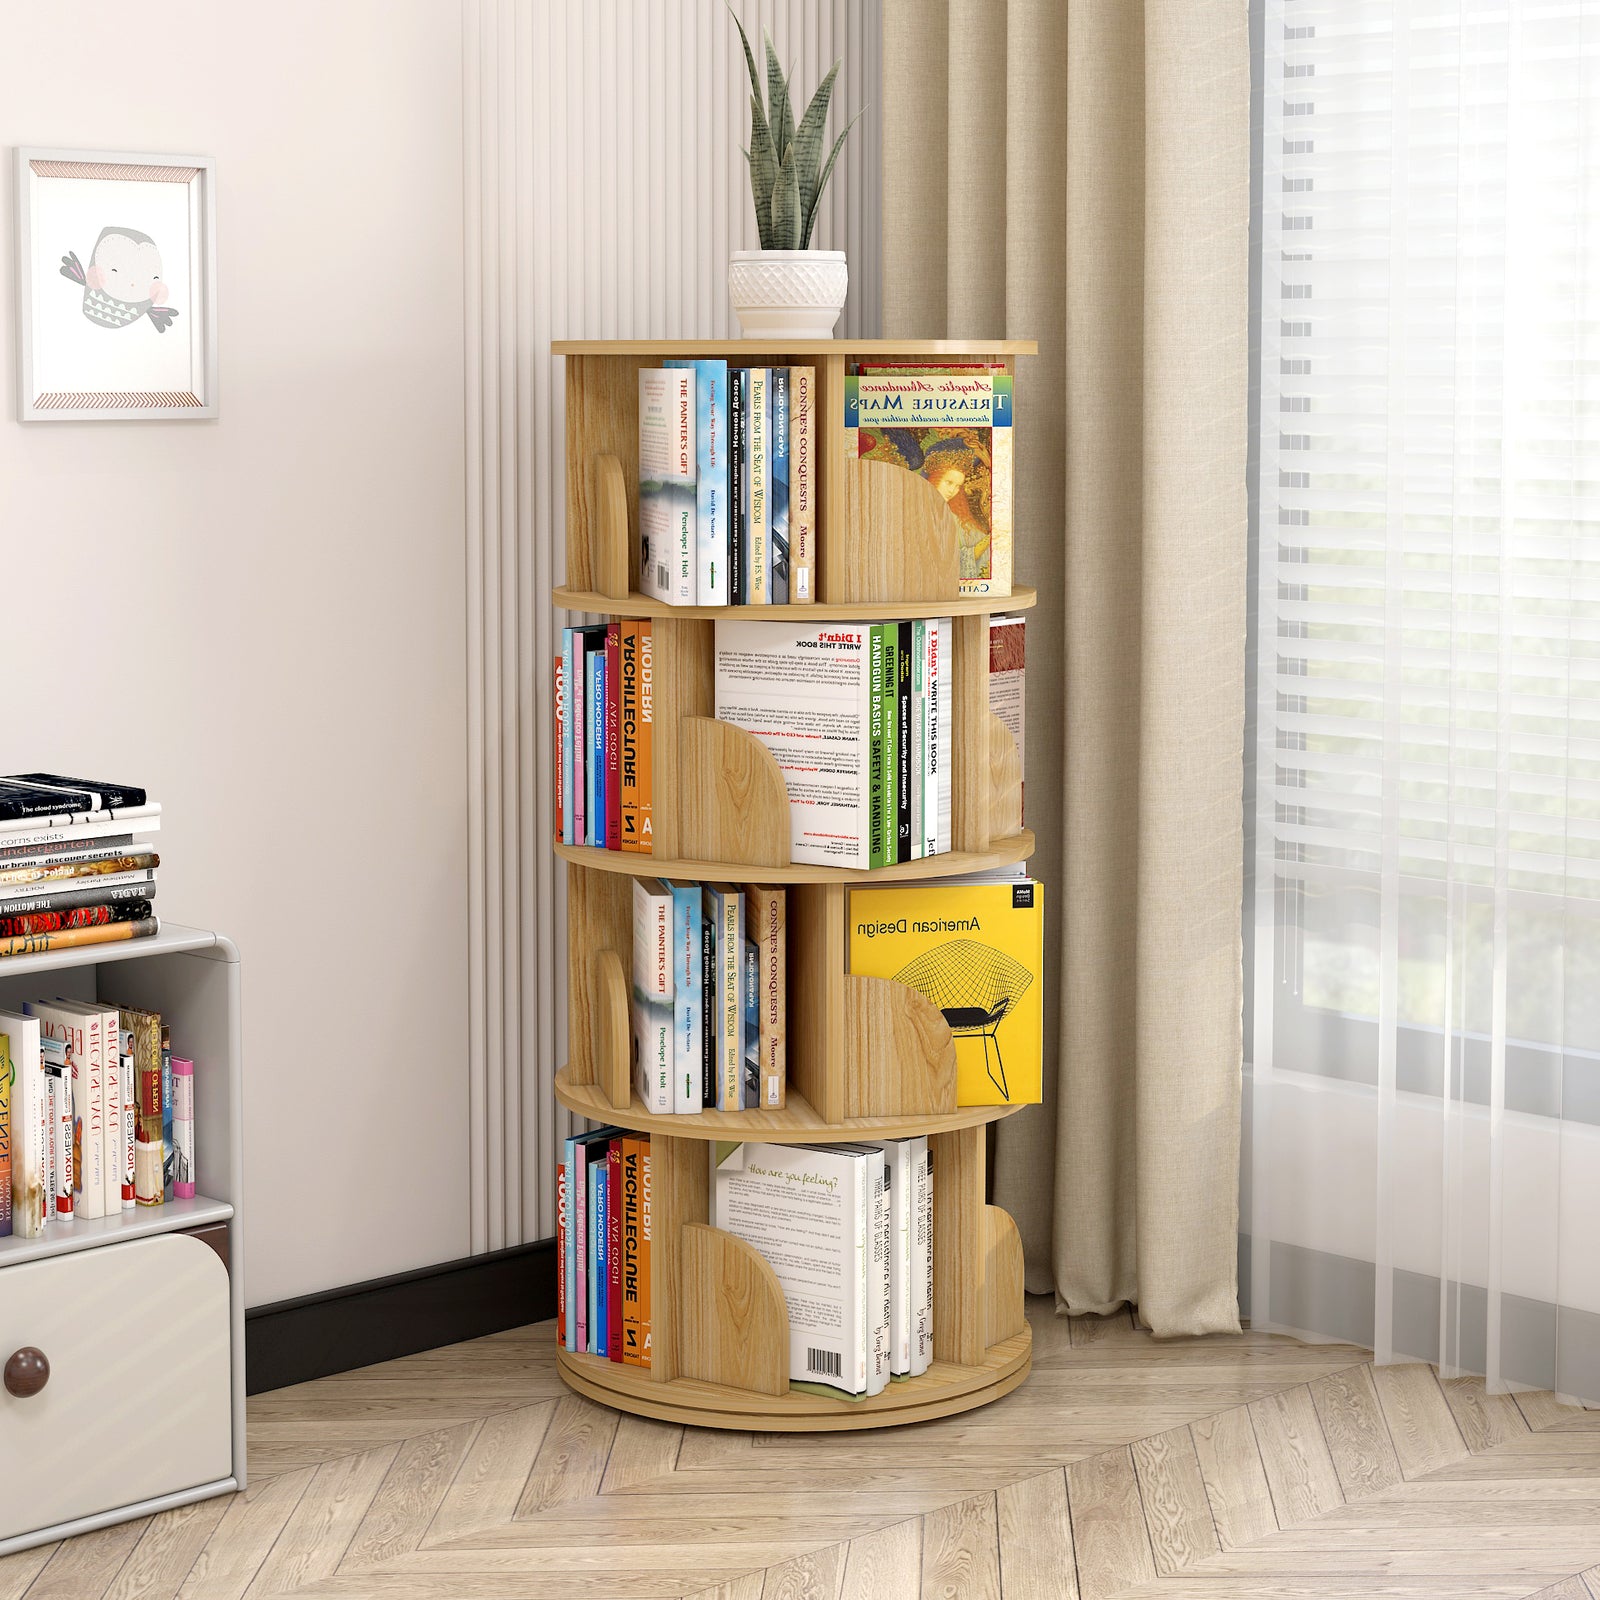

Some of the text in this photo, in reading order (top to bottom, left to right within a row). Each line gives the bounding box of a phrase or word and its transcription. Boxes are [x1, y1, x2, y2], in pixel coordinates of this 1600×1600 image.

[754, 381, 763, 410] PEARLS
[754, 454, 763, 474] SEAT
[754, 477, 761, 487] OF
[798, 438, 807, 512] CONQUESTS
[754, 490, 763, 524] WISDOM
[680, 512, 688, 549] Penelope
[754, 554, 762, 564] by
[886, 646, 894, 688] GREENING
[872, 636, 881, 854] HANDGUN BASICS SAFETY & HANDLING
[34, 833, 63, 841] exists
[11, 850, 122, 868] brain discover secrets
[44, 868, 74, 876] Poland
[111, 887, 146, 899] NADIA
[4, 900, 51, 913] THE MOTION
[728, 905, 736, 932] PEARLS
[728, 972, 736, 992] SEAT
[769, 956, 777, 1025] CONQUESTS
[728, 993, 735, 1002] OF
[728, 1005, 736, 1036] WISDOM
[748, 1164, 766, 1176] How
[784, 1172, 800, 1184] you
[803, 1172, 838, 1193] feeling?
[874, 1177, 882, 1263] THREE PAIRS OF GLASSES
[873, 1326, 883, 1334] by
[873, 1336, 883, 1352] Greg
